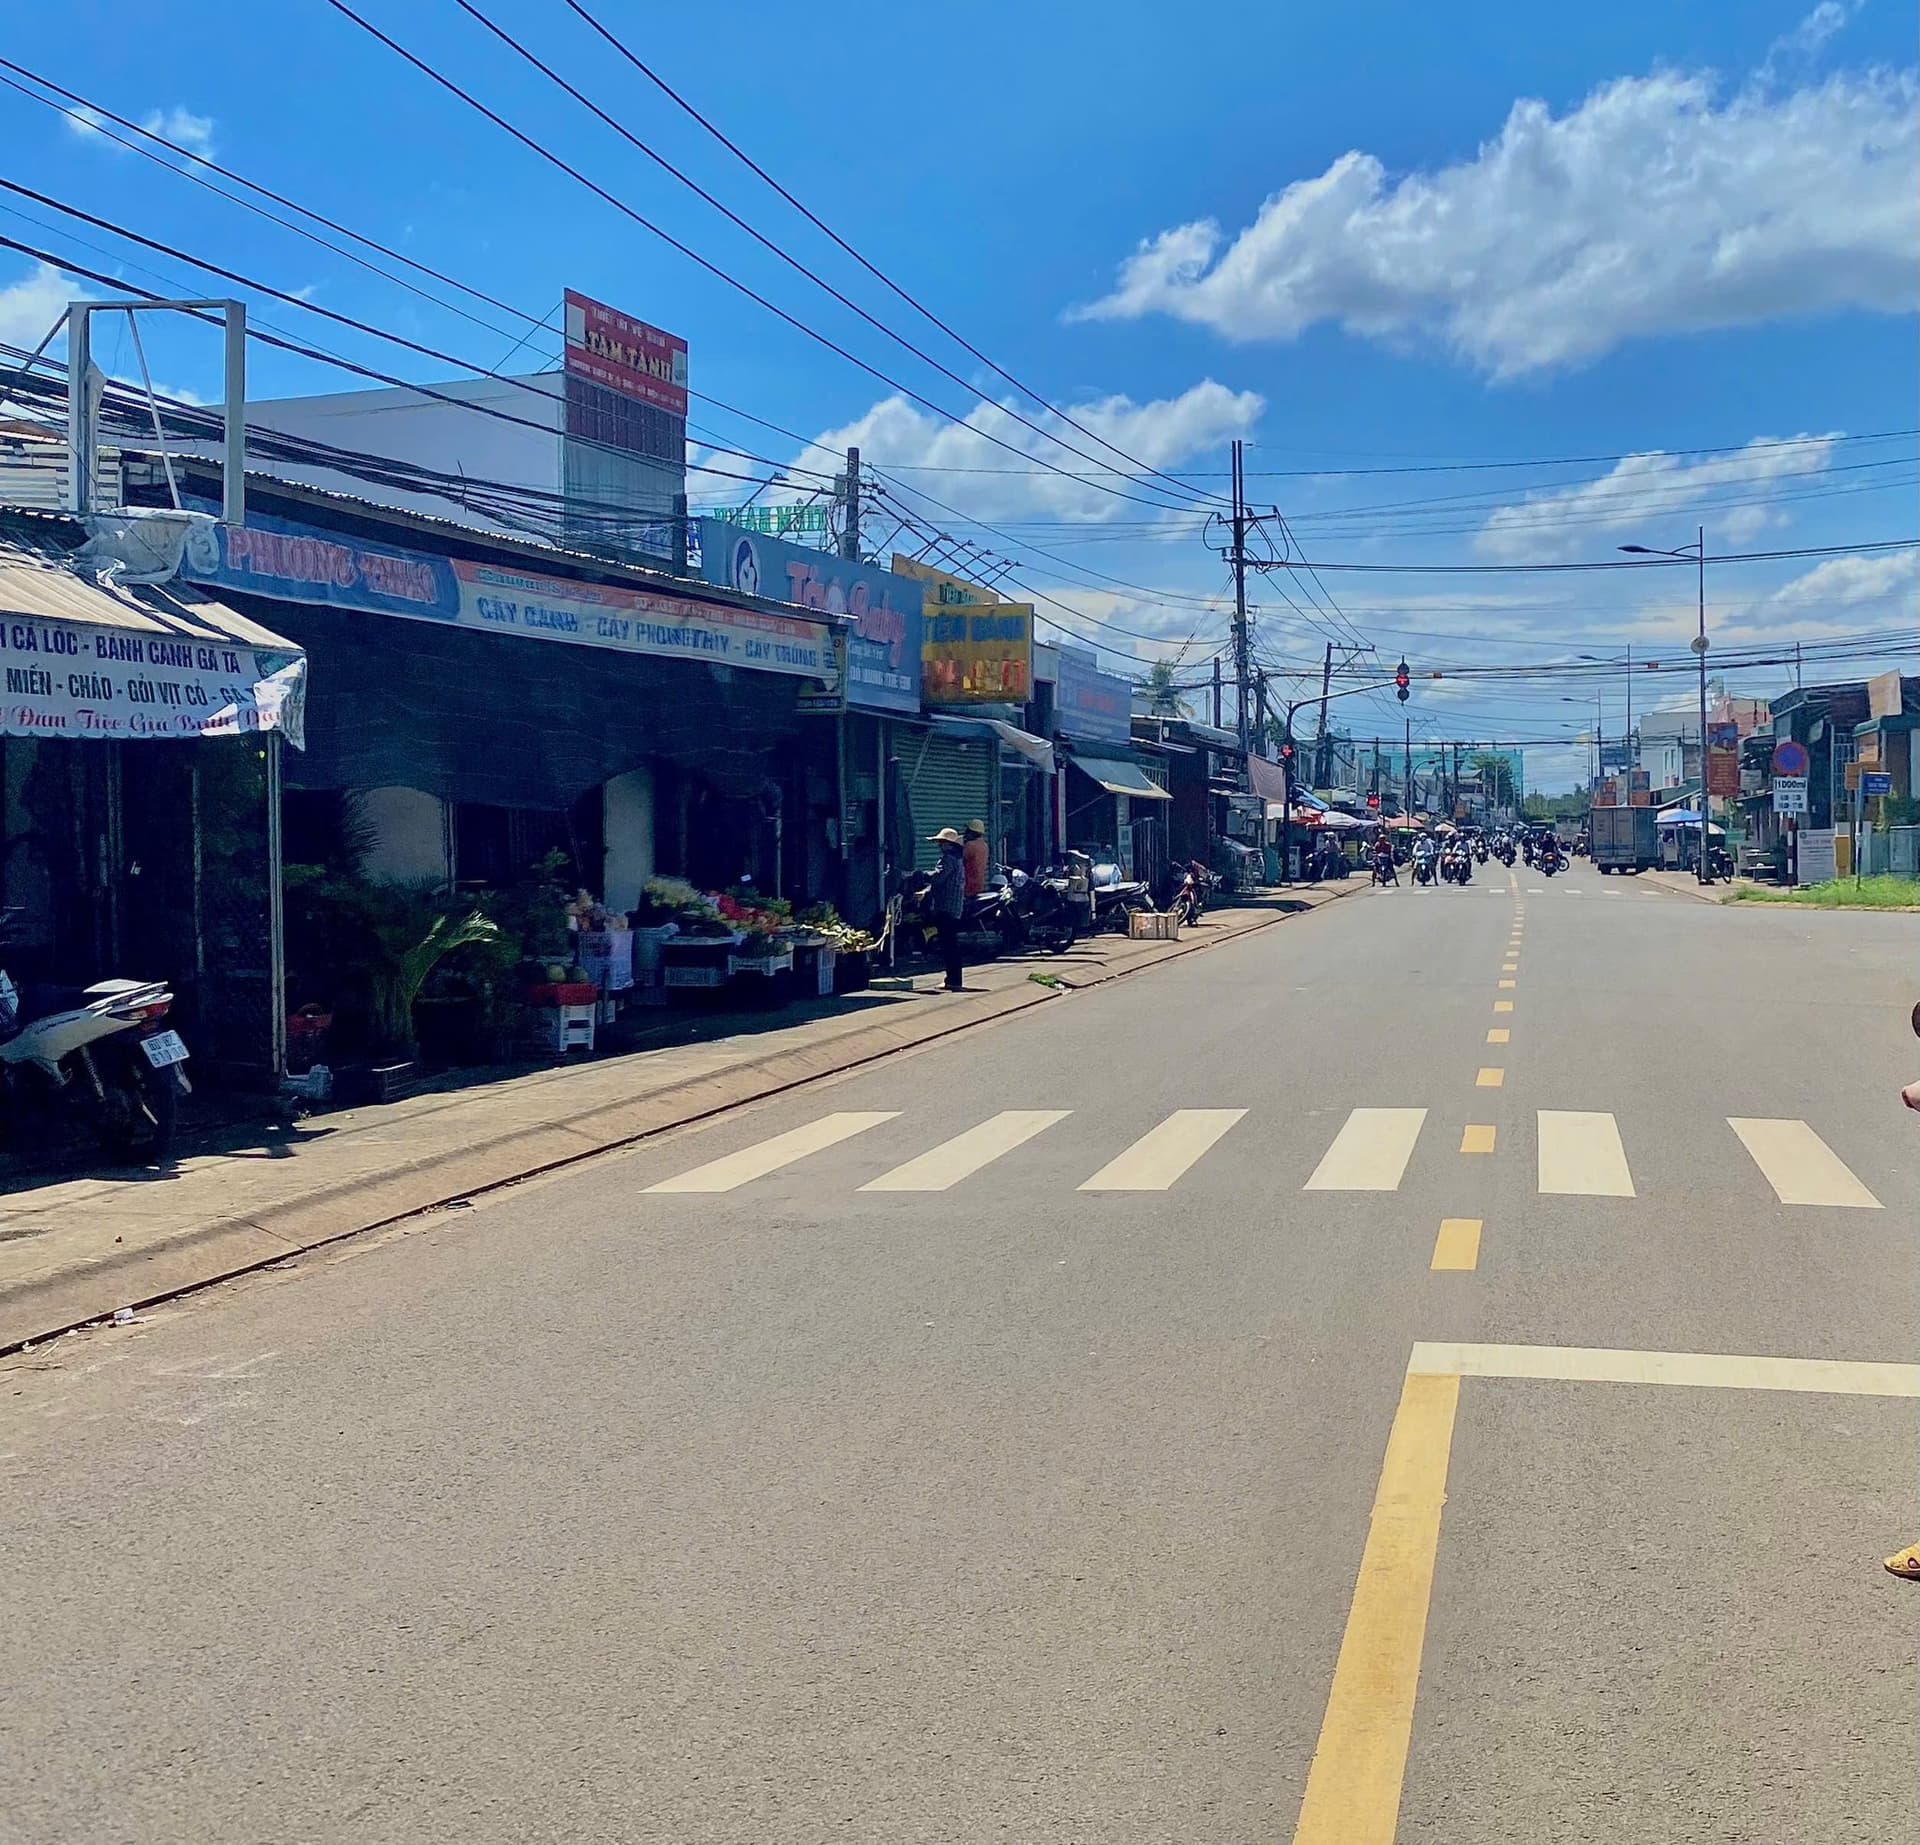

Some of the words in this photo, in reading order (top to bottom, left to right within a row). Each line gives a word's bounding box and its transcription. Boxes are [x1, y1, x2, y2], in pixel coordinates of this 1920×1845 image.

[96, 632, 144, 662] BÁNH
[149, 641, 193, 668] CANH
[222, 651, 241, 674] TA
[6, 664, 52, 695] MIẾN
[68, 671, 113, 700] CHÁO
[127, 672, 156, 703] GỎI
[158, 681, 182, 709] VỊT
